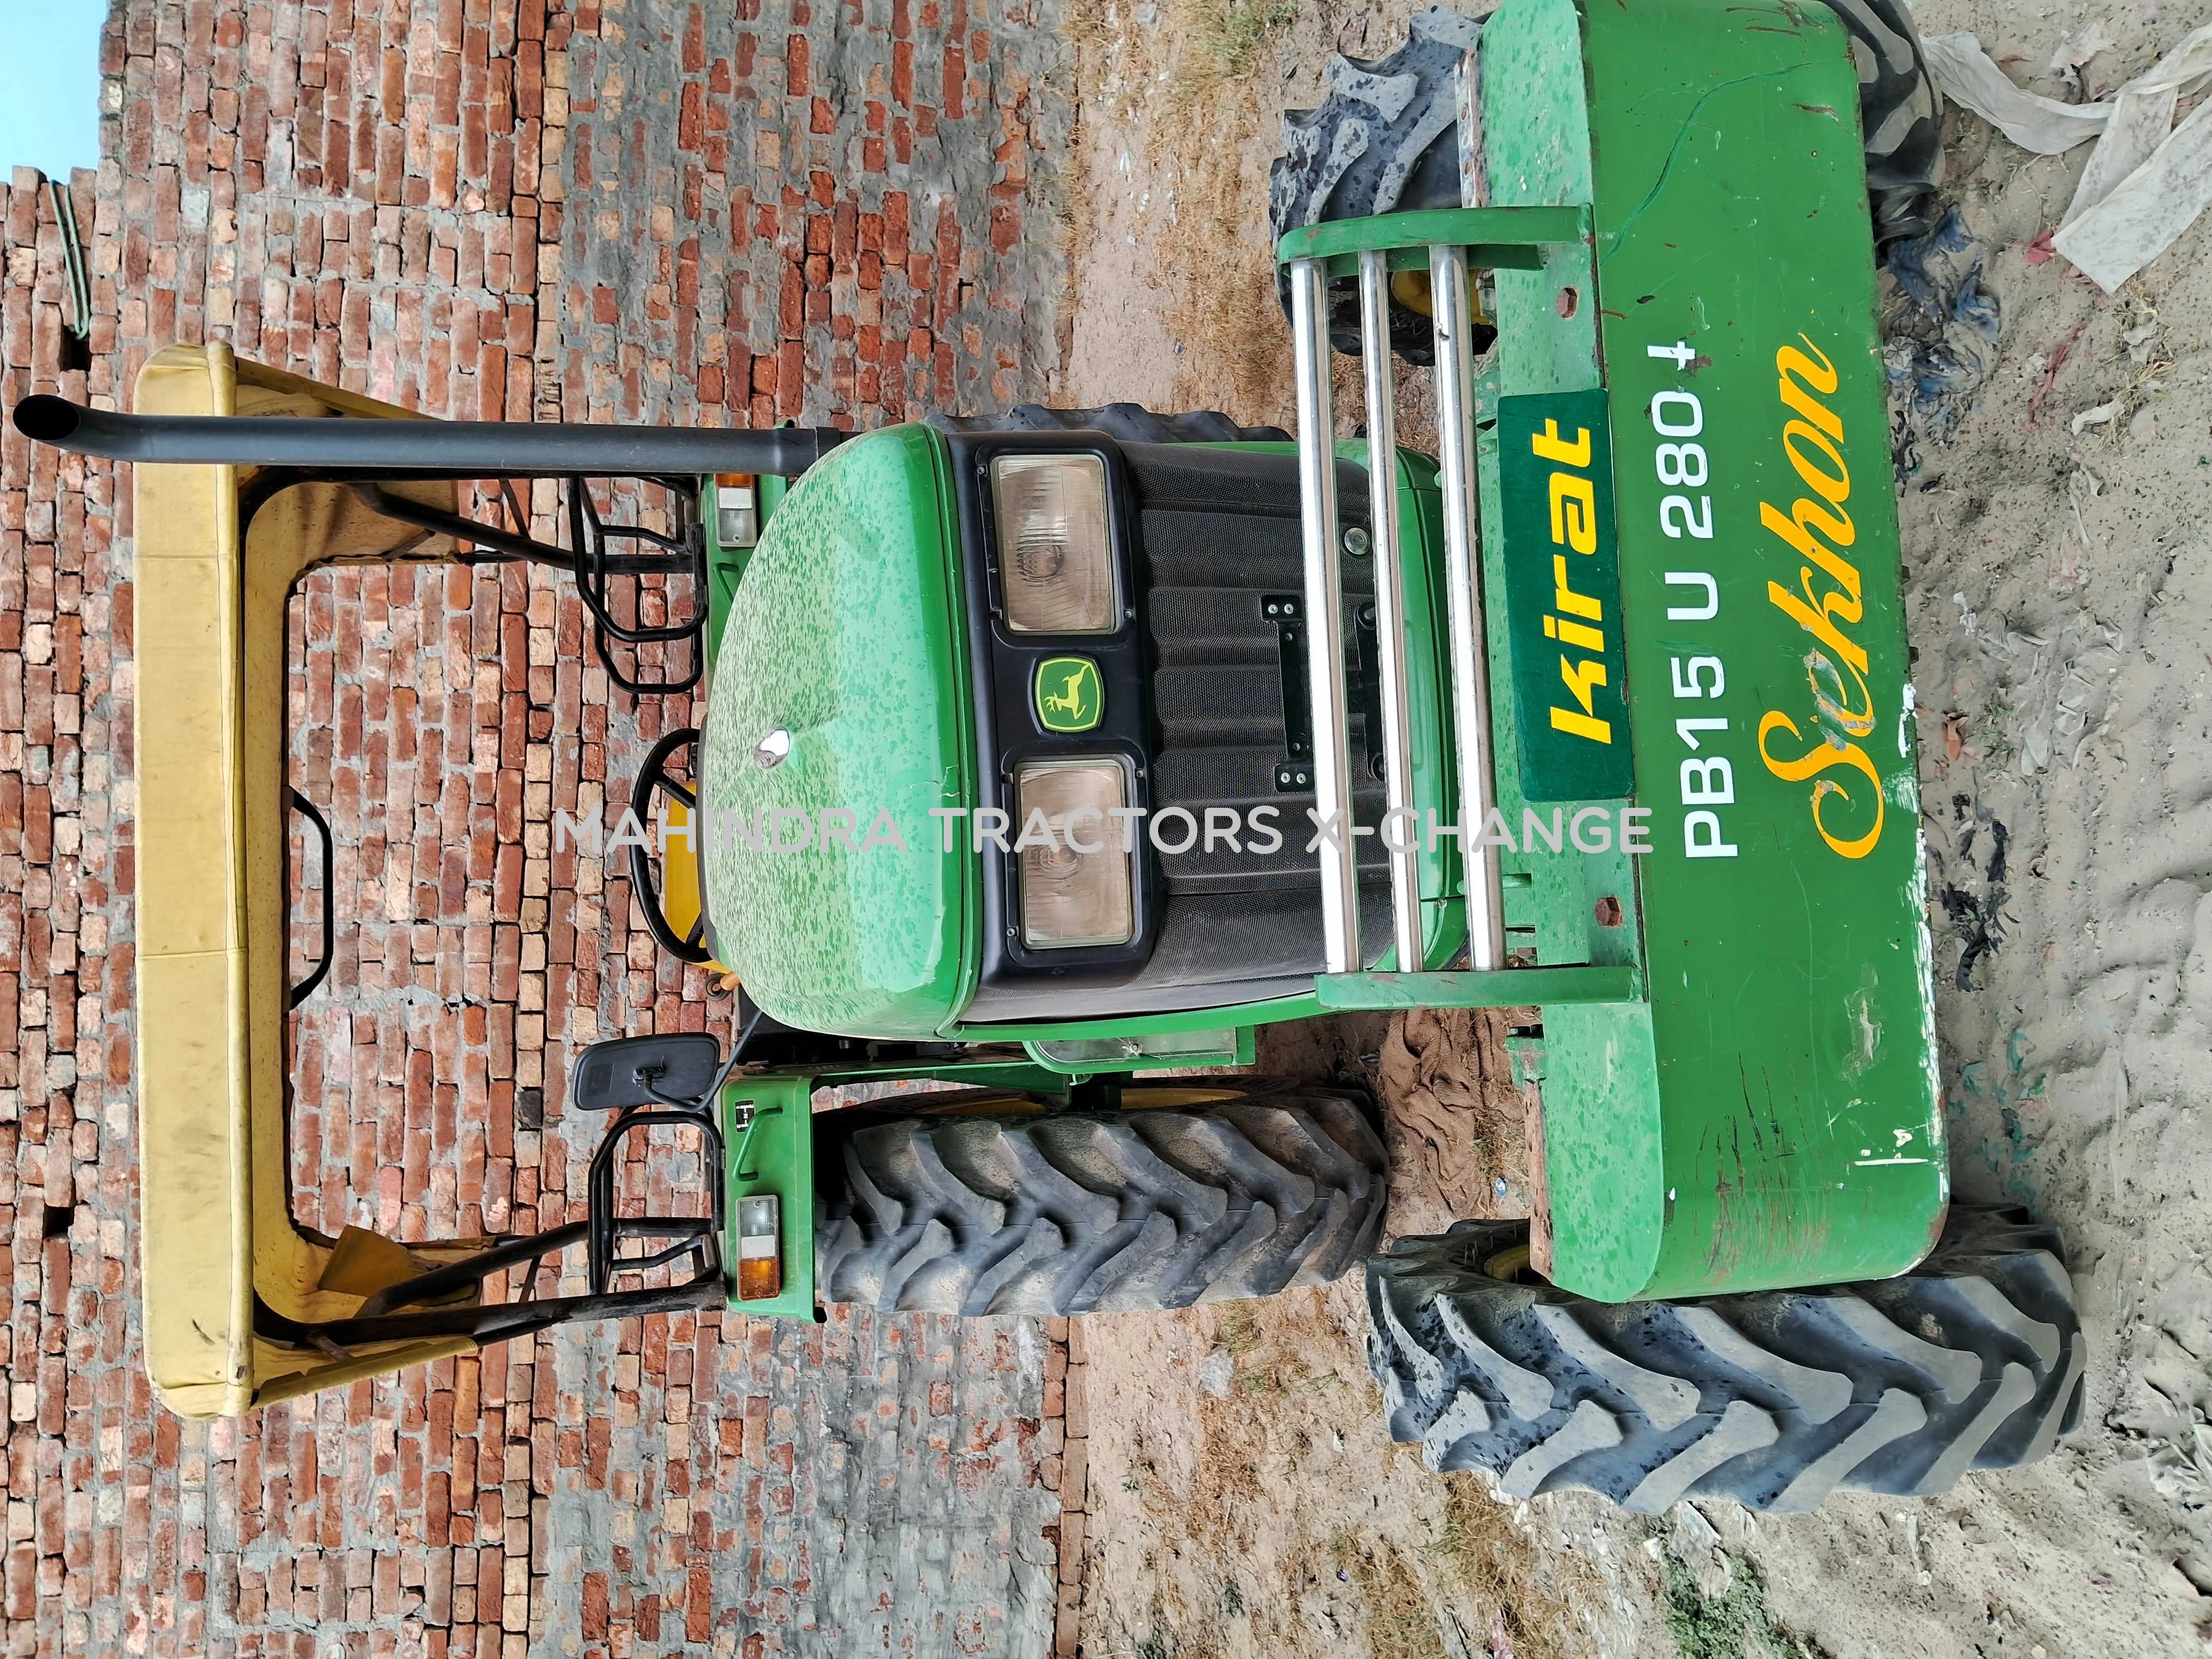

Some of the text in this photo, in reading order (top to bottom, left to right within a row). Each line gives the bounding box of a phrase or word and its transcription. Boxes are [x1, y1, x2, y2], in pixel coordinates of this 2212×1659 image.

[1533, 419, 1611, 744] kirat
[1664, 571, 1719, 621] U
[1758, 333, 1885, 859] Sekhon
[1671, 656, 1738, 858] PB15
